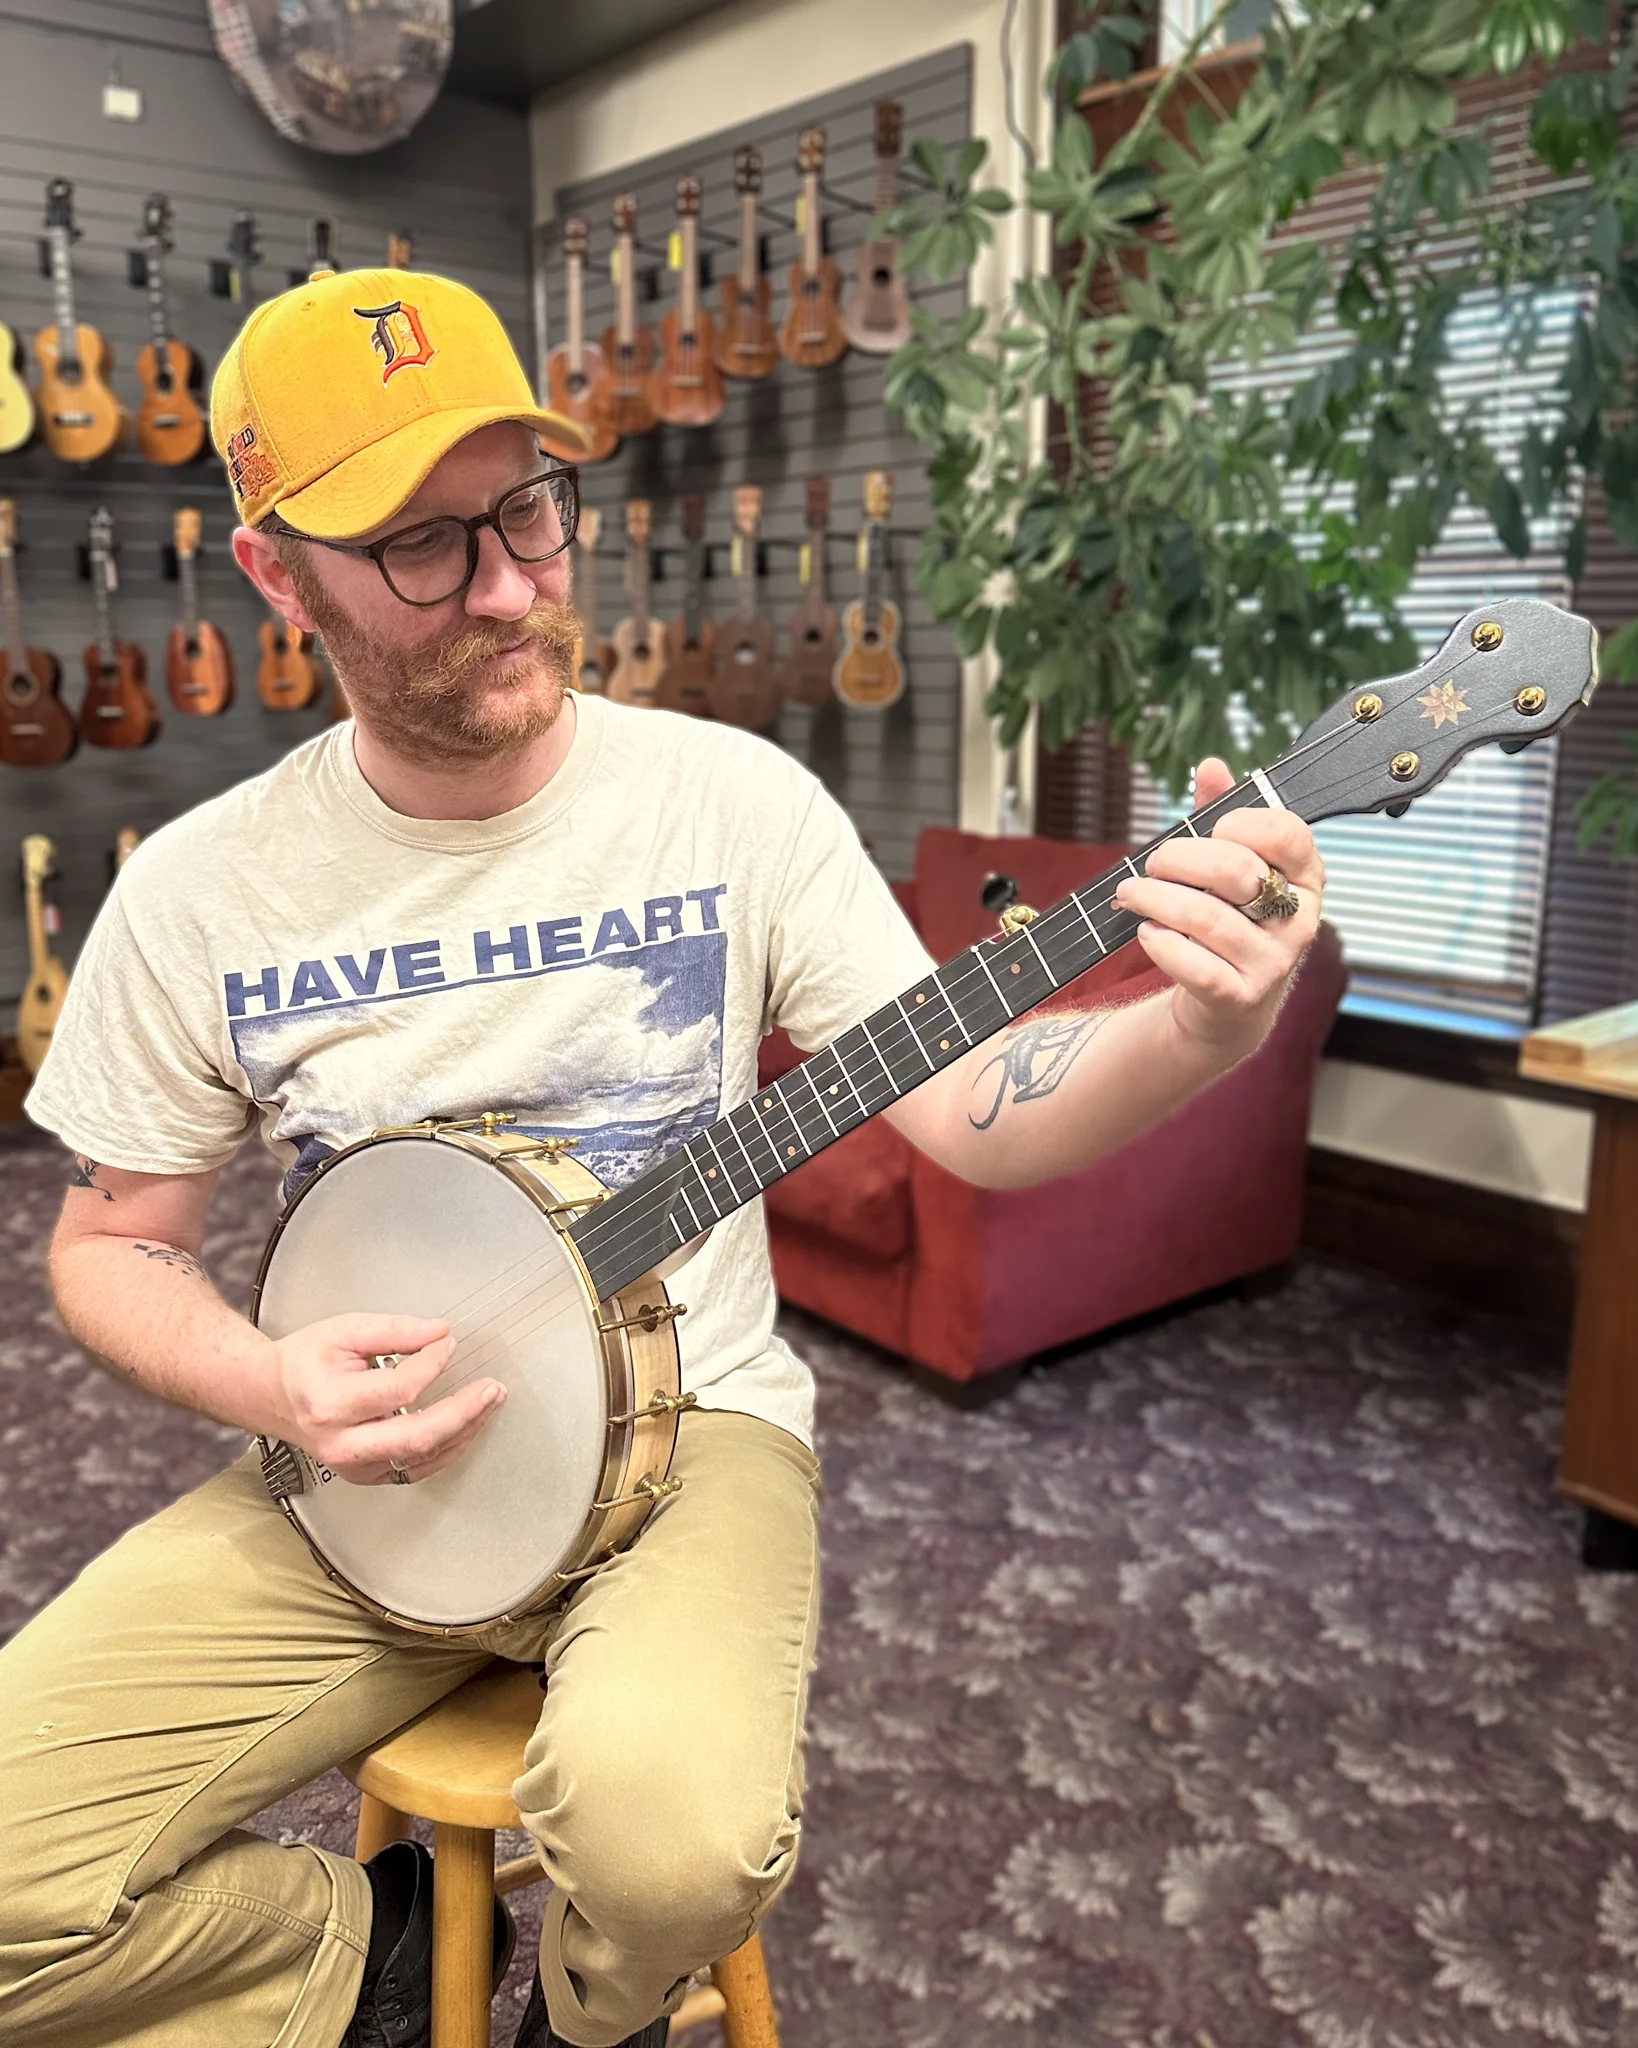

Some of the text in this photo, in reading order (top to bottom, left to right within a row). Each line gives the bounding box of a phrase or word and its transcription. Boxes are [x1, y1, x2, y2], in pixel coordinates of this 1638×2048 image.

[352, 300, 436, 385] D
[223, 883, 728, 1017] HAVE HEART
